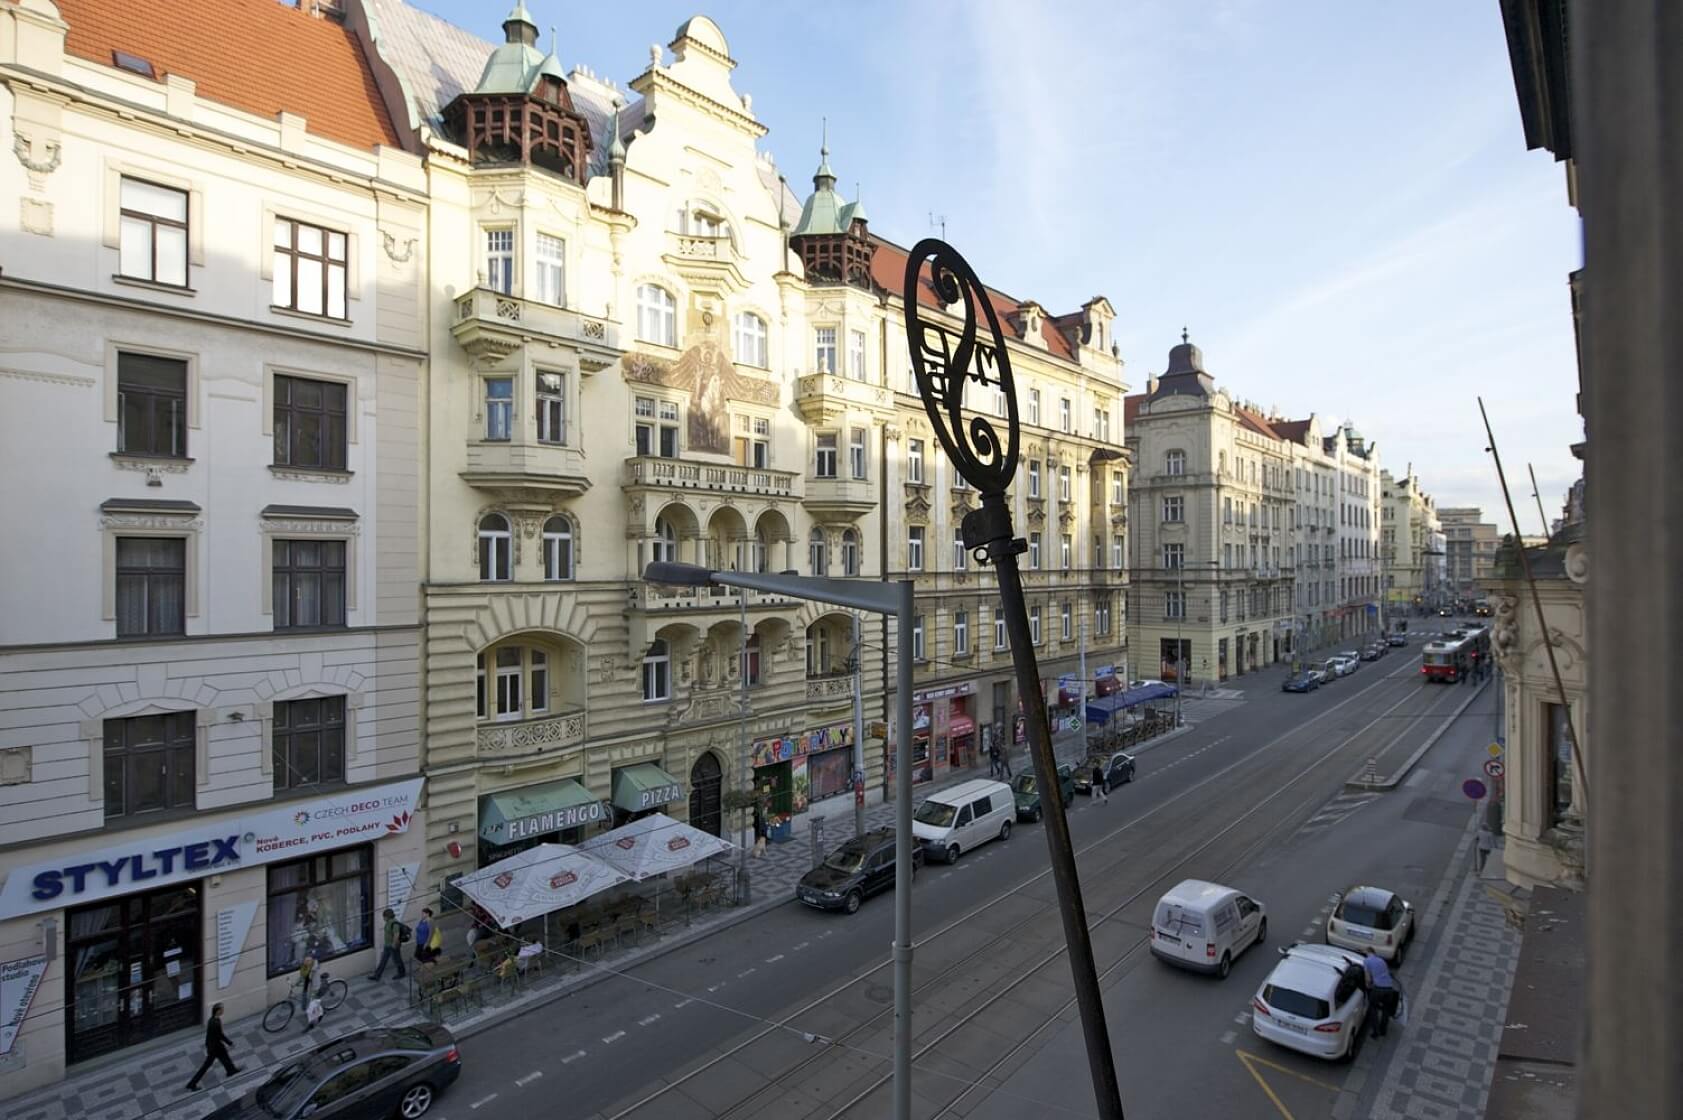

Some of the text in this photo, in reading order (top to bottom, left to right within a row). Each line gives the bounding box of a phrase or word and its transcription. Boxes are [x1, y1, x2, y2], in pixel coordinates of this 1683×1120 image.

[314, 795, 408, 820] CZECH DECO TEAM
[641, 785, 681, 807] PIZZA
[336, 823, 380, 838] PODLAHY
[508, 805, 600, 840] FLAMENGO
[31, 836, 240, 901] STYLTEX
